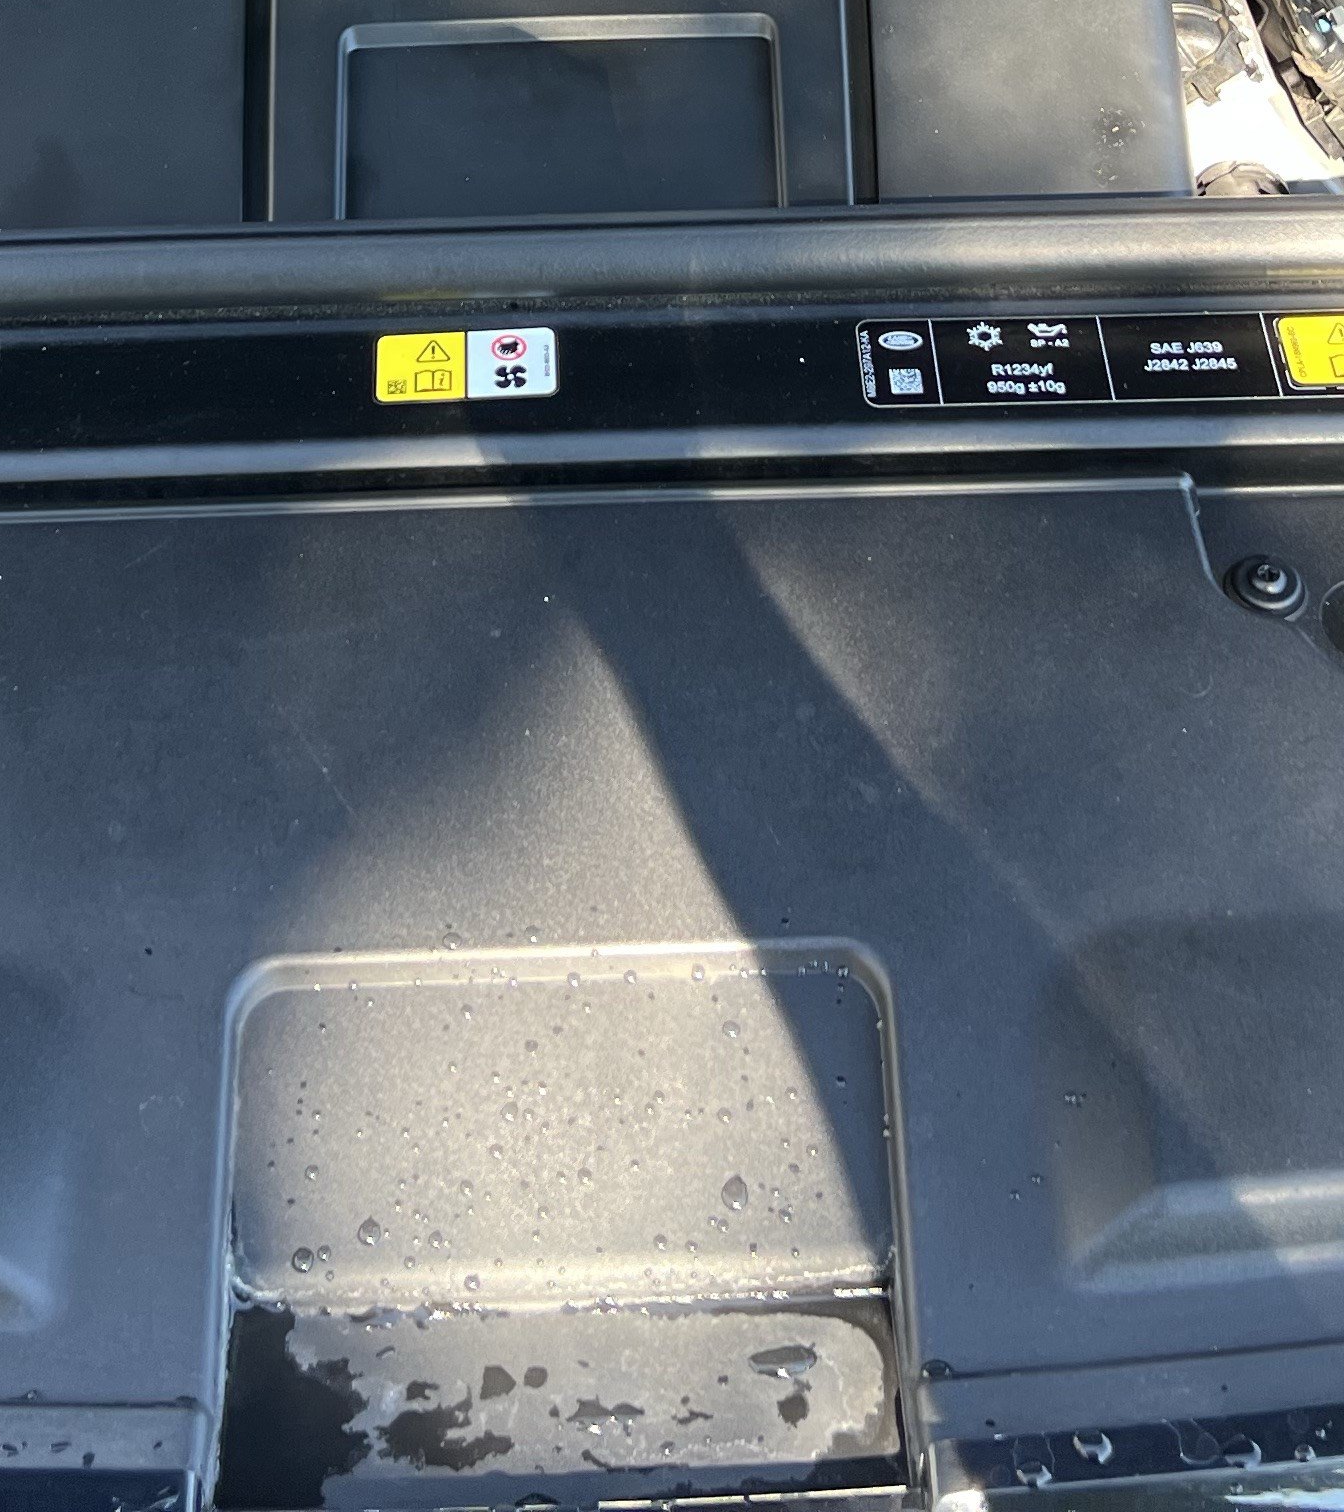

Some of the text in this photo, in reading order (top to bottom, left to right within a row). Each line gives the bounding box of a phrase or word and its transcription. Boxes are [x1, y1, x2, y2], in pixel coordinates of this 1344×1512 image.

[1149, 340, 1223, 354] SAE J639
[990, 362, 1054, 378] R1234yf
[1144, 357, 1238, 372] J2842 J2845
[986, 379, 1067, 395] 950g ±10g
